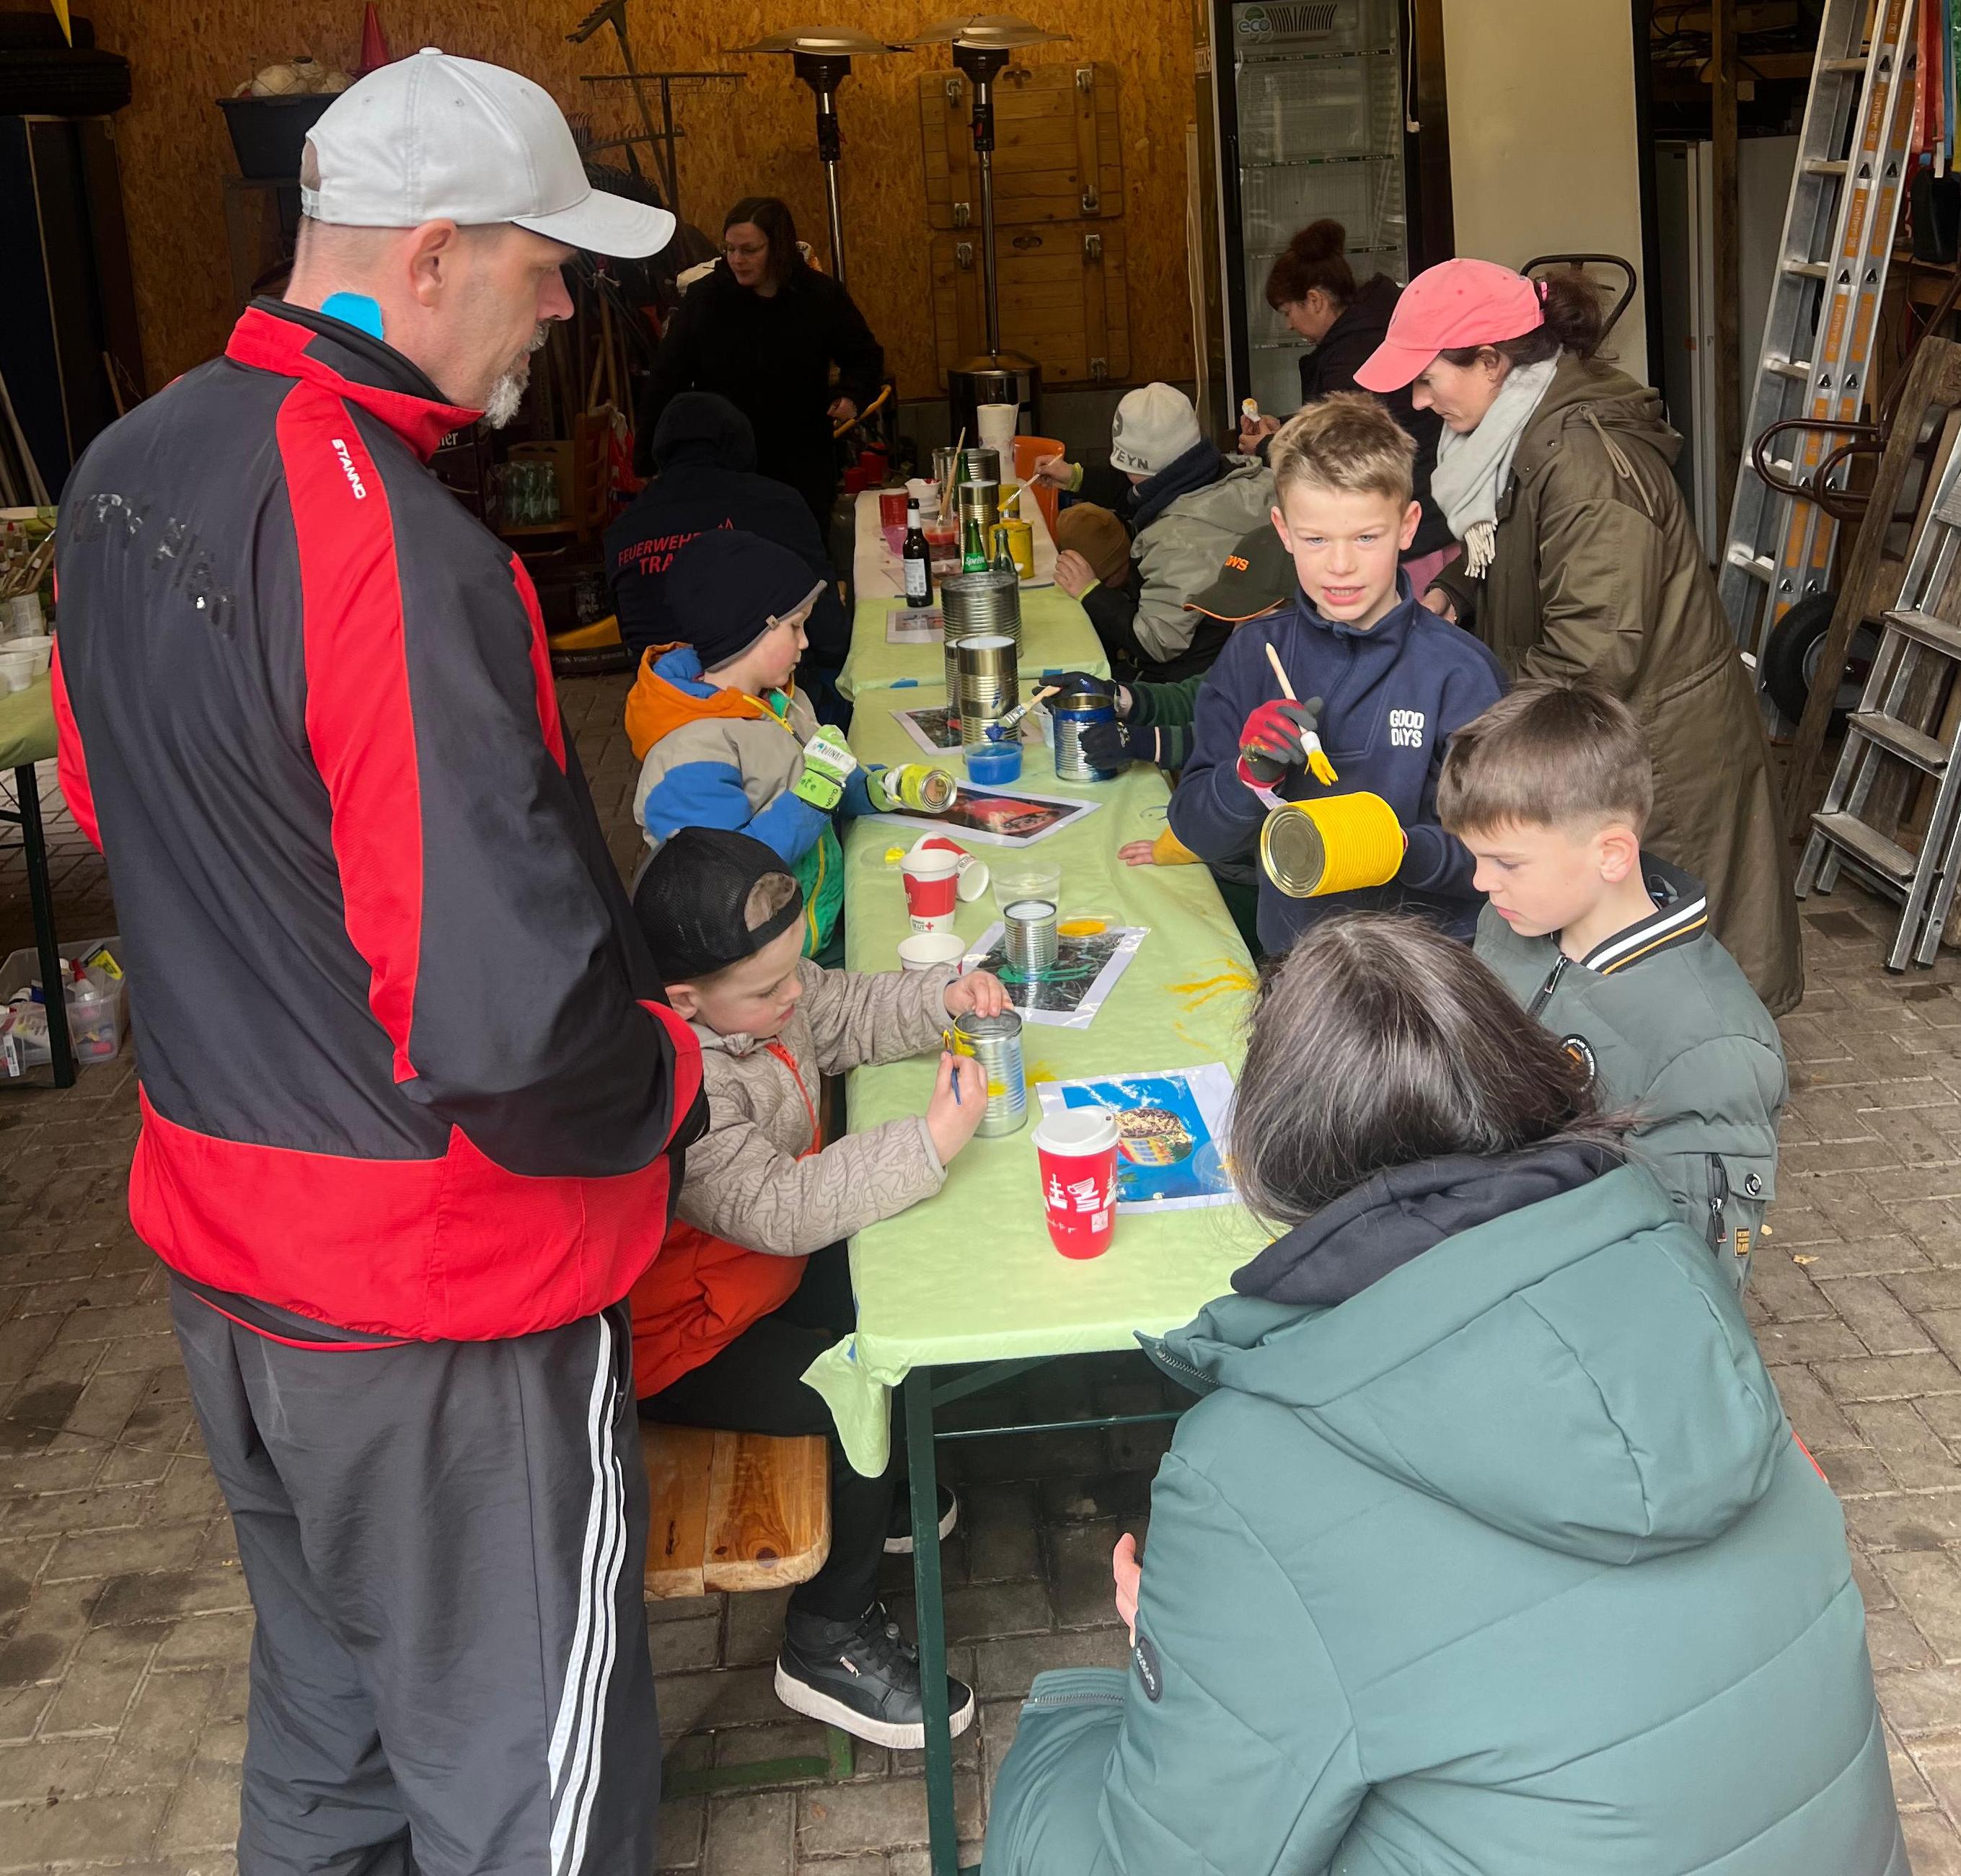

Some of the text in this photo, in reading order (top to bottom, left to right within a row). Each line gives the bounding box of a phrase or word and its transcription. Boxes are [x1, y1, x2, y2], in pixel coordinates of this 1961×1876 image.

[1238, 19, 1271, 34] eco
[332, 439, 366, 499] STANNO
[1390, 709, 1424, 729] GOOD
[1391, 728, 1422, 748] DAYS
